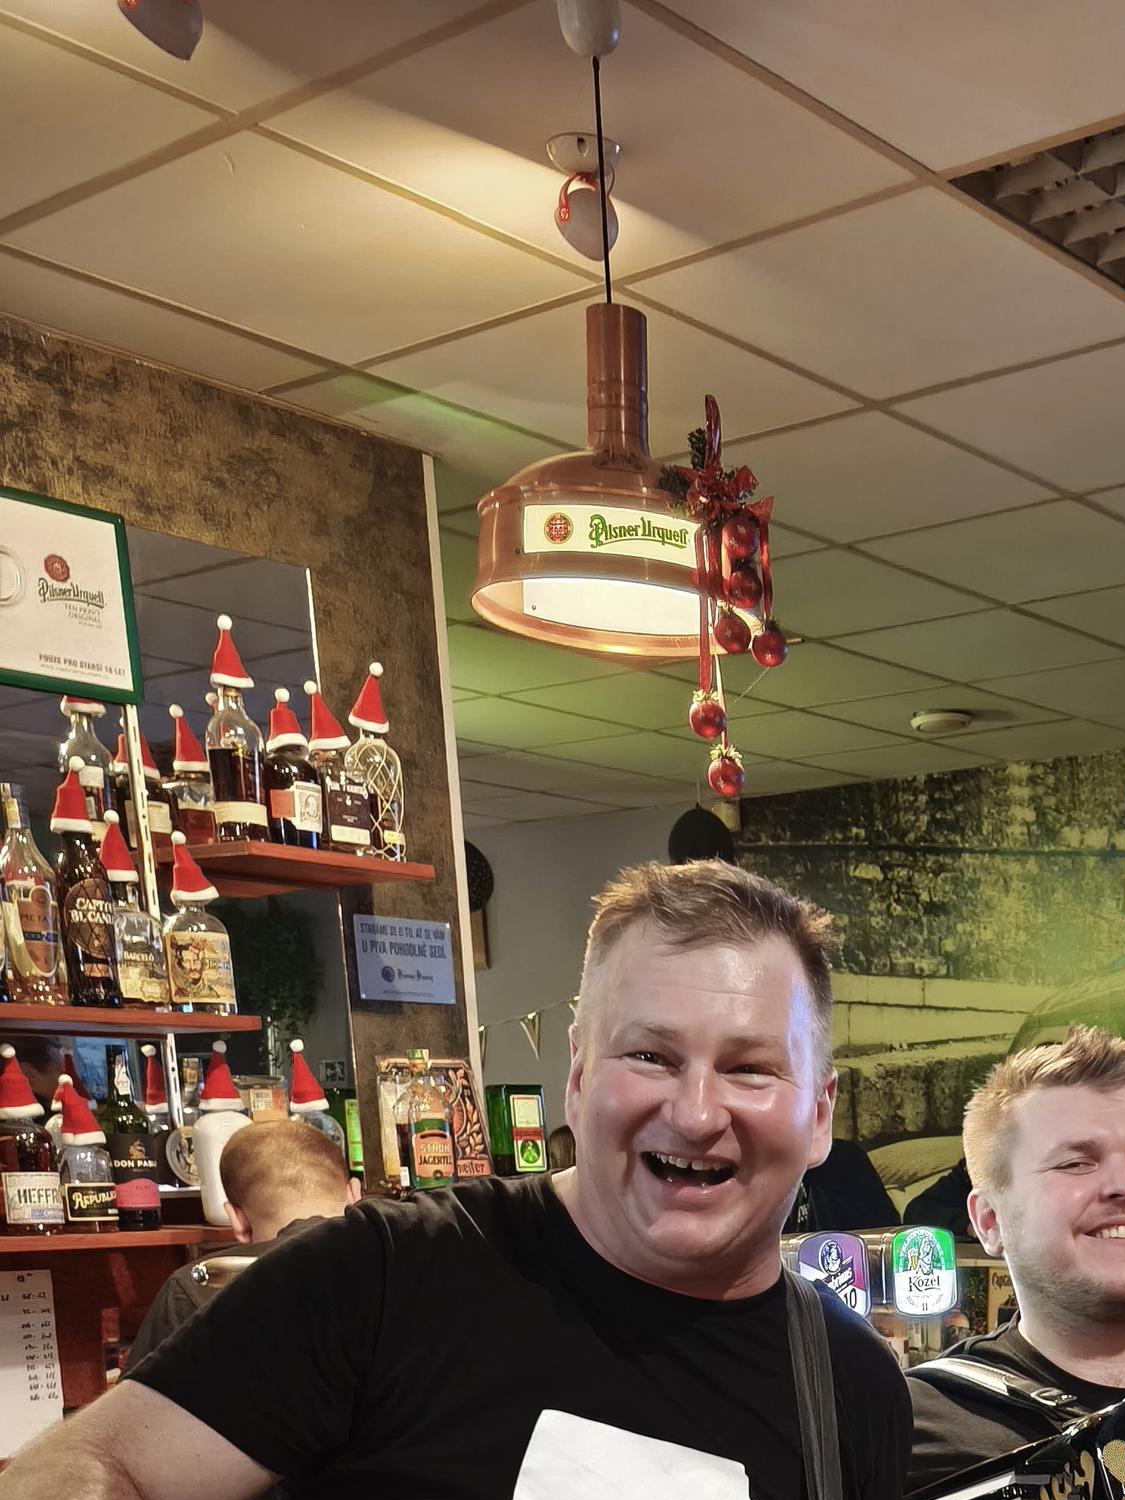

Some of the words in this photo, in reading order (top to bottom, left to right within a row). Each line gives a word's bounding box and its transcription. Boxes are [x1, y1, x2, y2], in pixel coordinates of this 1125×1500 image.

[589, 513, 641, 548] Pilsner
[641, 516, 690, 549] Urquell
[38, 577, 72, 603] Pilsner
[70, 582, 104, 608] Urquell
[370, 940, 387, 954] PIVA
[908, 1276, 941, 1292] Kozel
